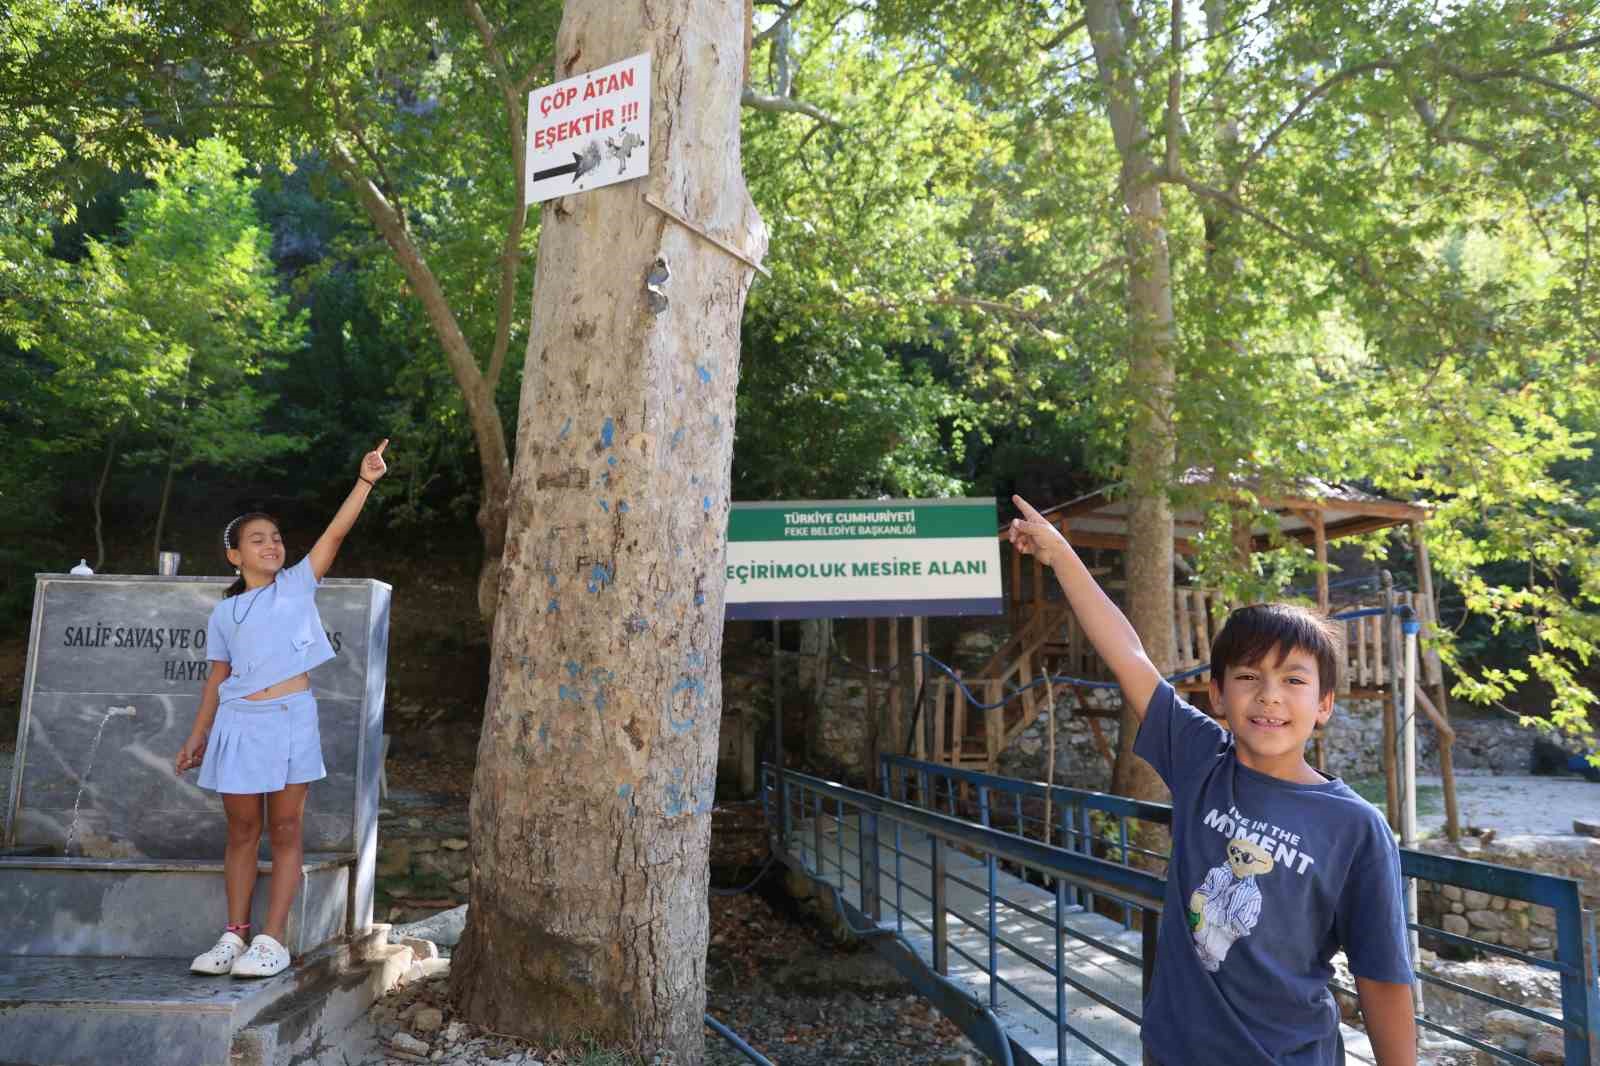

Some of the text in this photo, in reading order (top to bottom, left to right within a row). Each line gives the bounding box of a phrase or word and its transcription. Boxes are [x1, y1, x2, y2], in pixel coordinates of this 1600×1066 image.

[540, 67, 635, 118] ÇÖP ATAN
[533, 102, 640, 150] EŞEKTİR !!!
[783, 509, 916, 524] TÜRKİYE CUMHURİYETİ
[784, 523, 917, 536] FEKE BELEDİYE BAŞKANLIĞI
[726, 556, 987, 584] EÇİRİMOLUK MESİRE ALANI
[63, 622, 112, 647] SALİF
[114, 627, 165, 653] SAVAŞ
[168, 629, 191, 649] VE
[164, 661, 208, 681] HAYR
[1251, 820, 1269, 832] IN
[1271, 825, 1301, 846] THE
